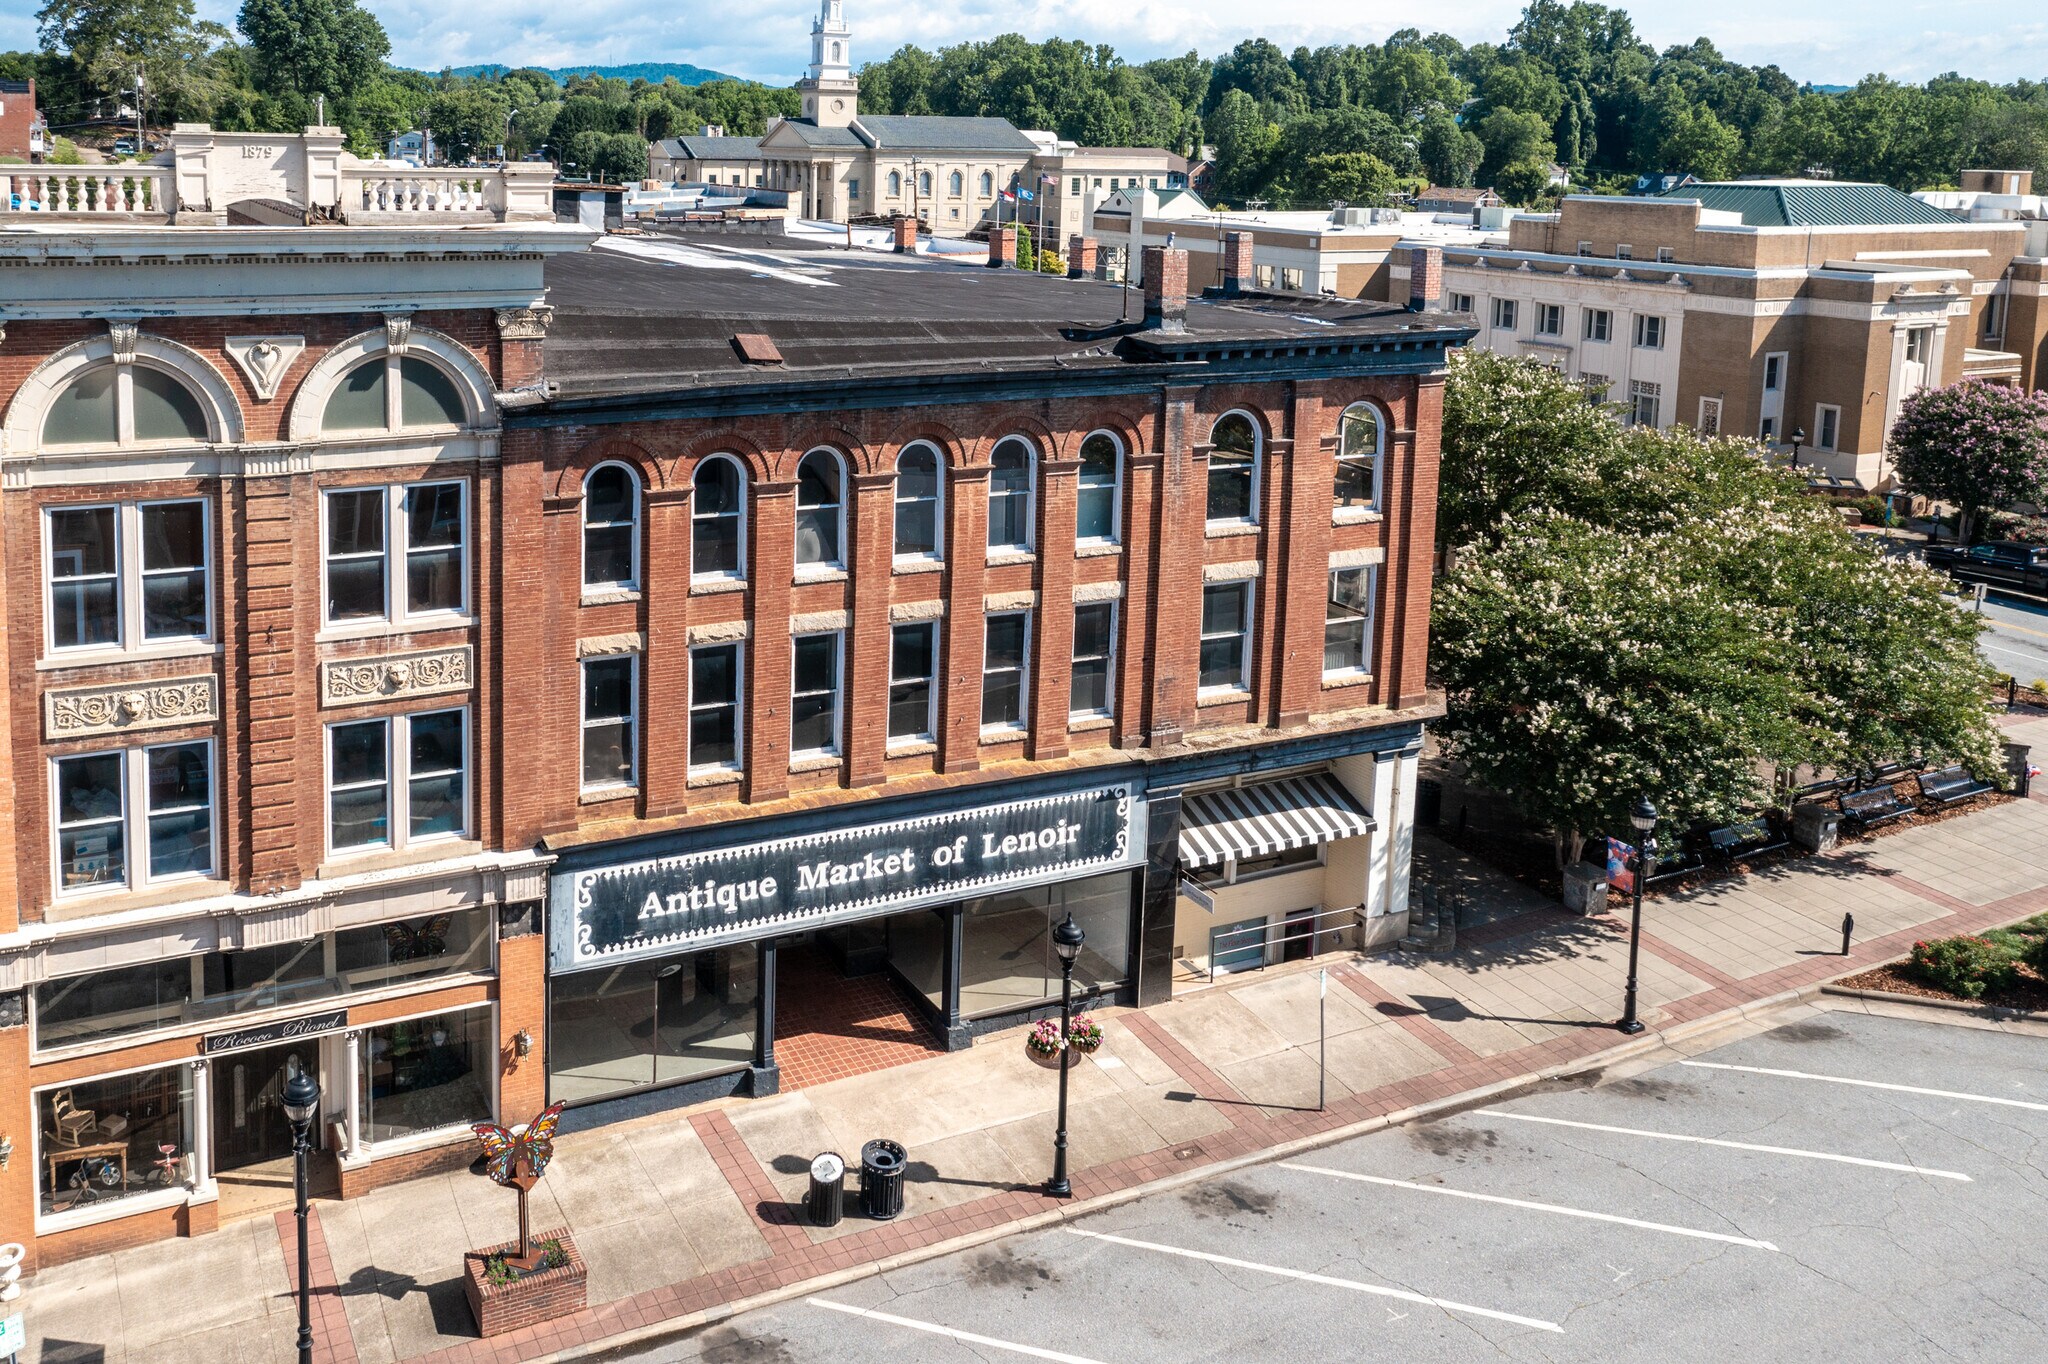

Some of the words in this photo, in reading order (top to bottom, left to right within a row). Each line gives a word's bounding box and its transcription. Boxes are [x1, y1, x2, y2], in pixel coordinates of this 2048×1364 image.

[242, 145, 272, 159] 1879
[637, 876, 778, 920] Antique
[797, 847, 916, 891] Market
[932, 835, 968, 866] of
[982, 818, 1081, 859] Lenoir
[213, 1032, 273, 1050] Rococo
[282, 1015, 341, 1036] Rionel
[414, 1126, 430, 1135] GIFTS
[74, 1201, 95, 1210] HOME
[96, 1195, 119, 1205] DECOR
[124, 1189, 149, 1199] DESIGN
